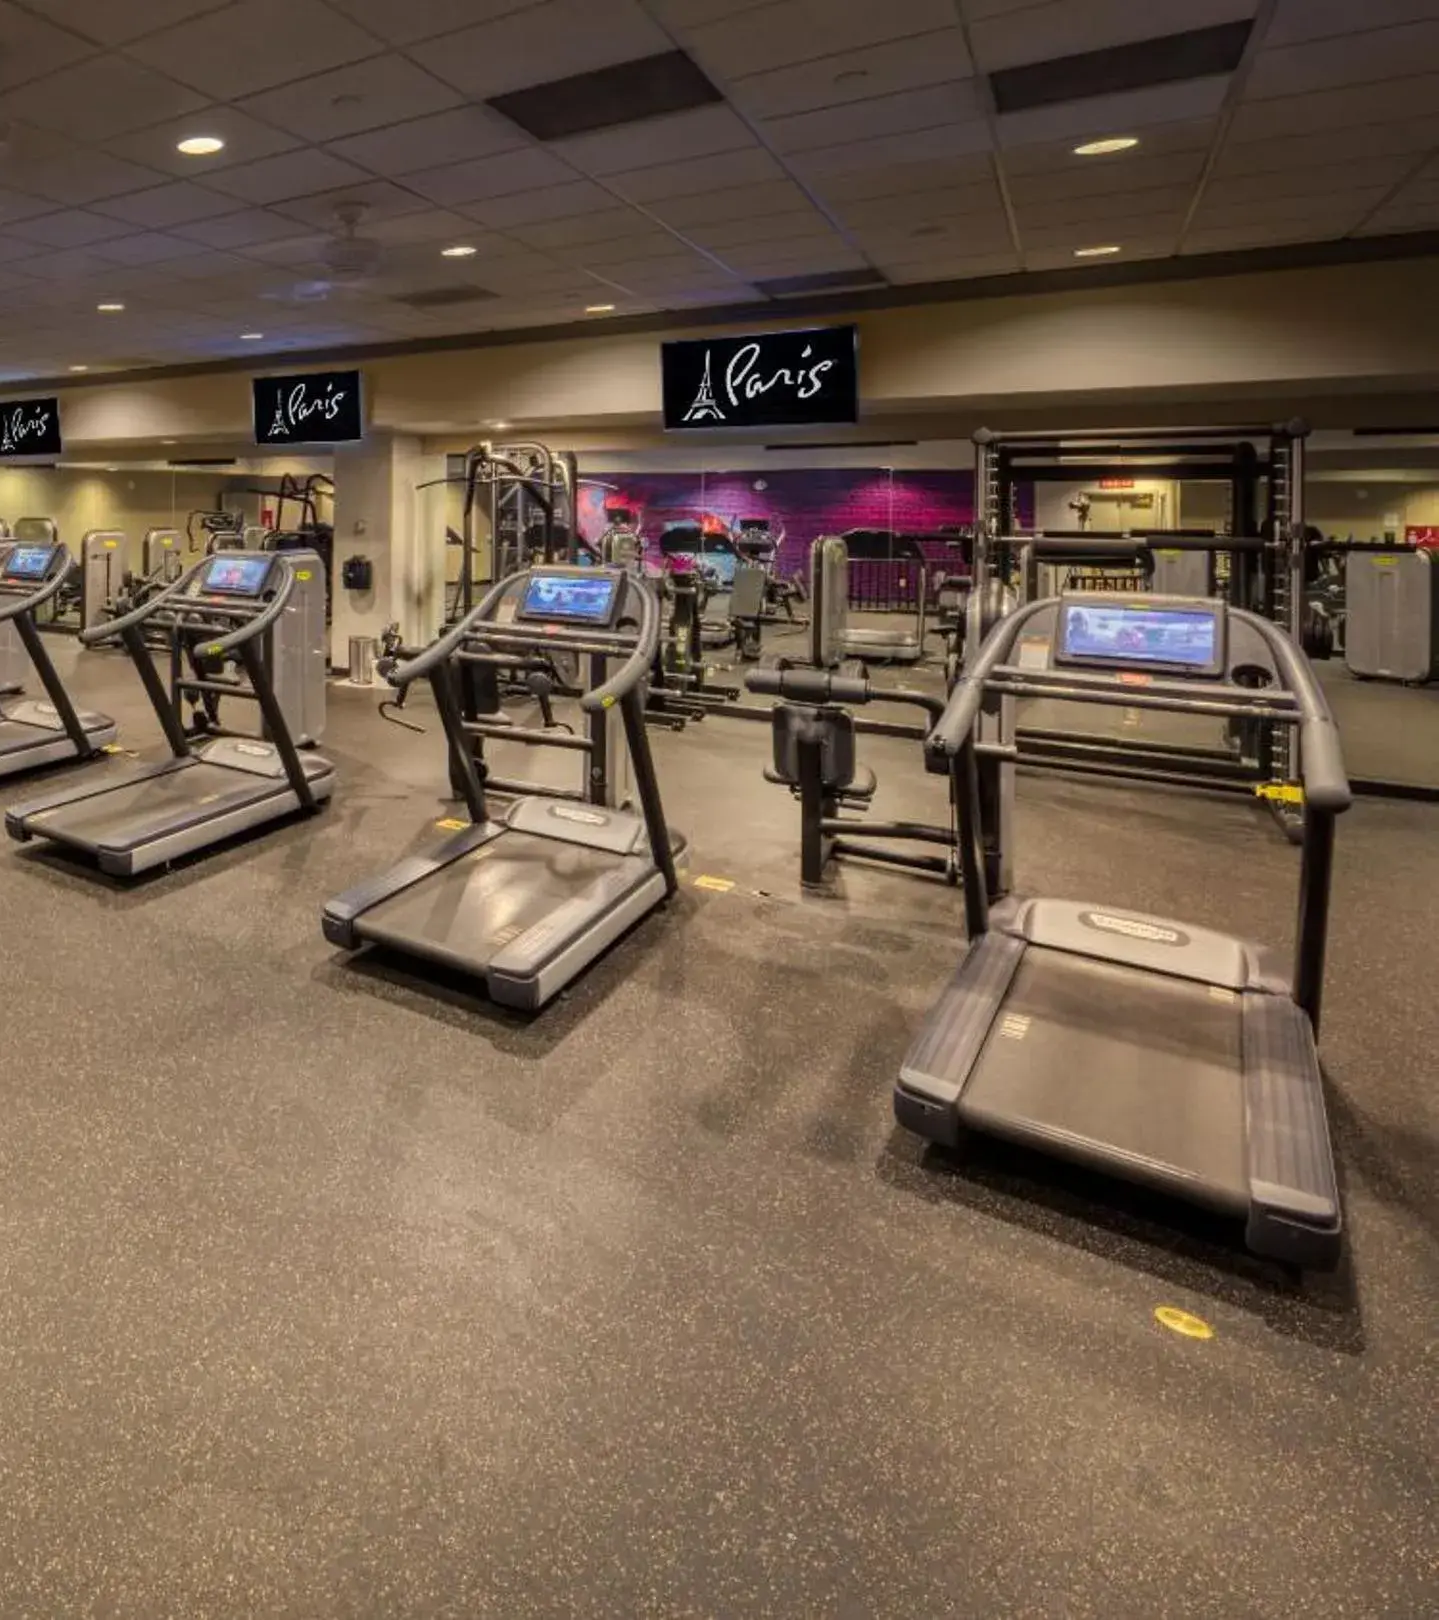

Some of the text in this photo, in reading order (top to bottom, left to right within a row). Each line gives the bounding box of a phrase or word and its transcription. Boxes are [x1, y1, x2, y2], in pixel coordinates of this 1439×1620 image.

[726, 343, 834, 406] Paris
[12, 406, 50, 442] Paris
[288, 383, 345, 425] Paris
